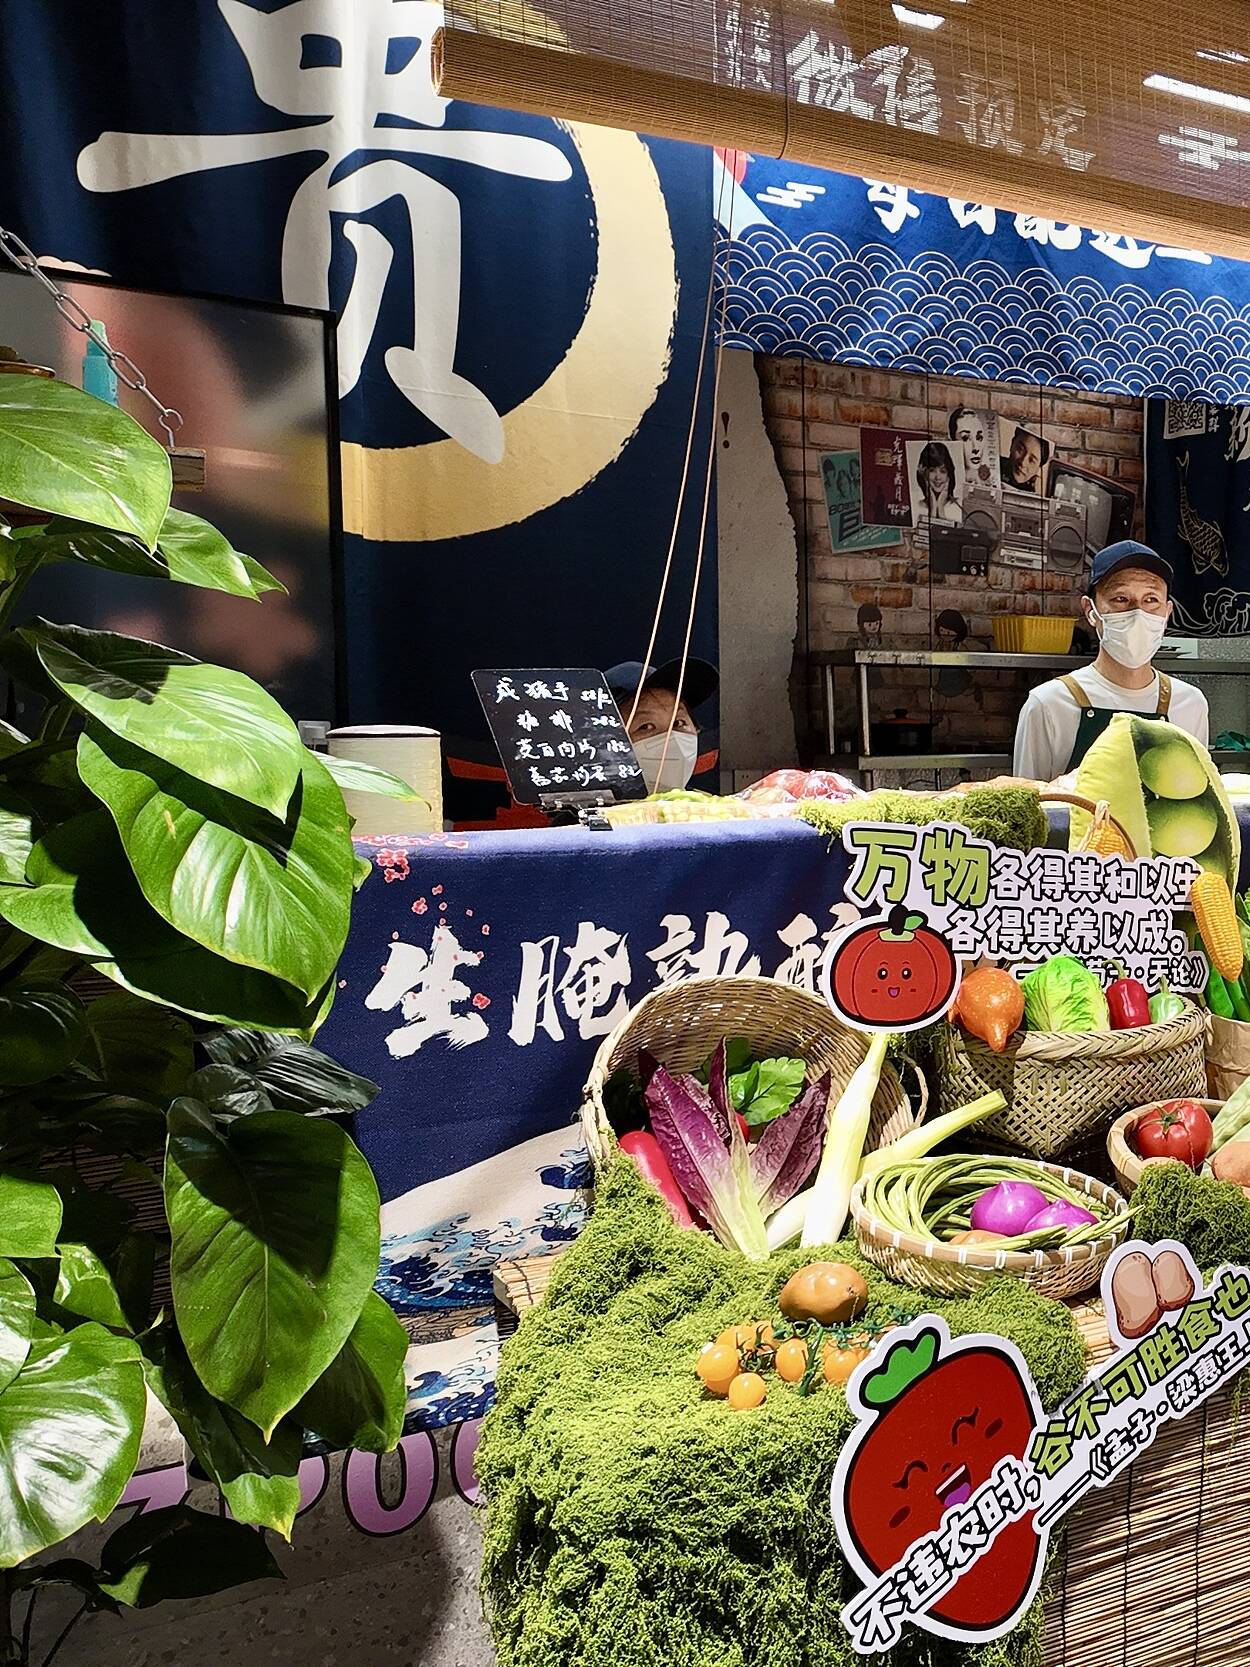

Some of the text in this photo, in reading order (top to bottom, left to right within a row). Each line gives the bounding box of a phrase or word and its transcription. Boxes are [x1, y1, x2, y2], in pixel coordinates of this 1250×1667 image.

[944, 905, 1185, 955] 各得其养以成。
